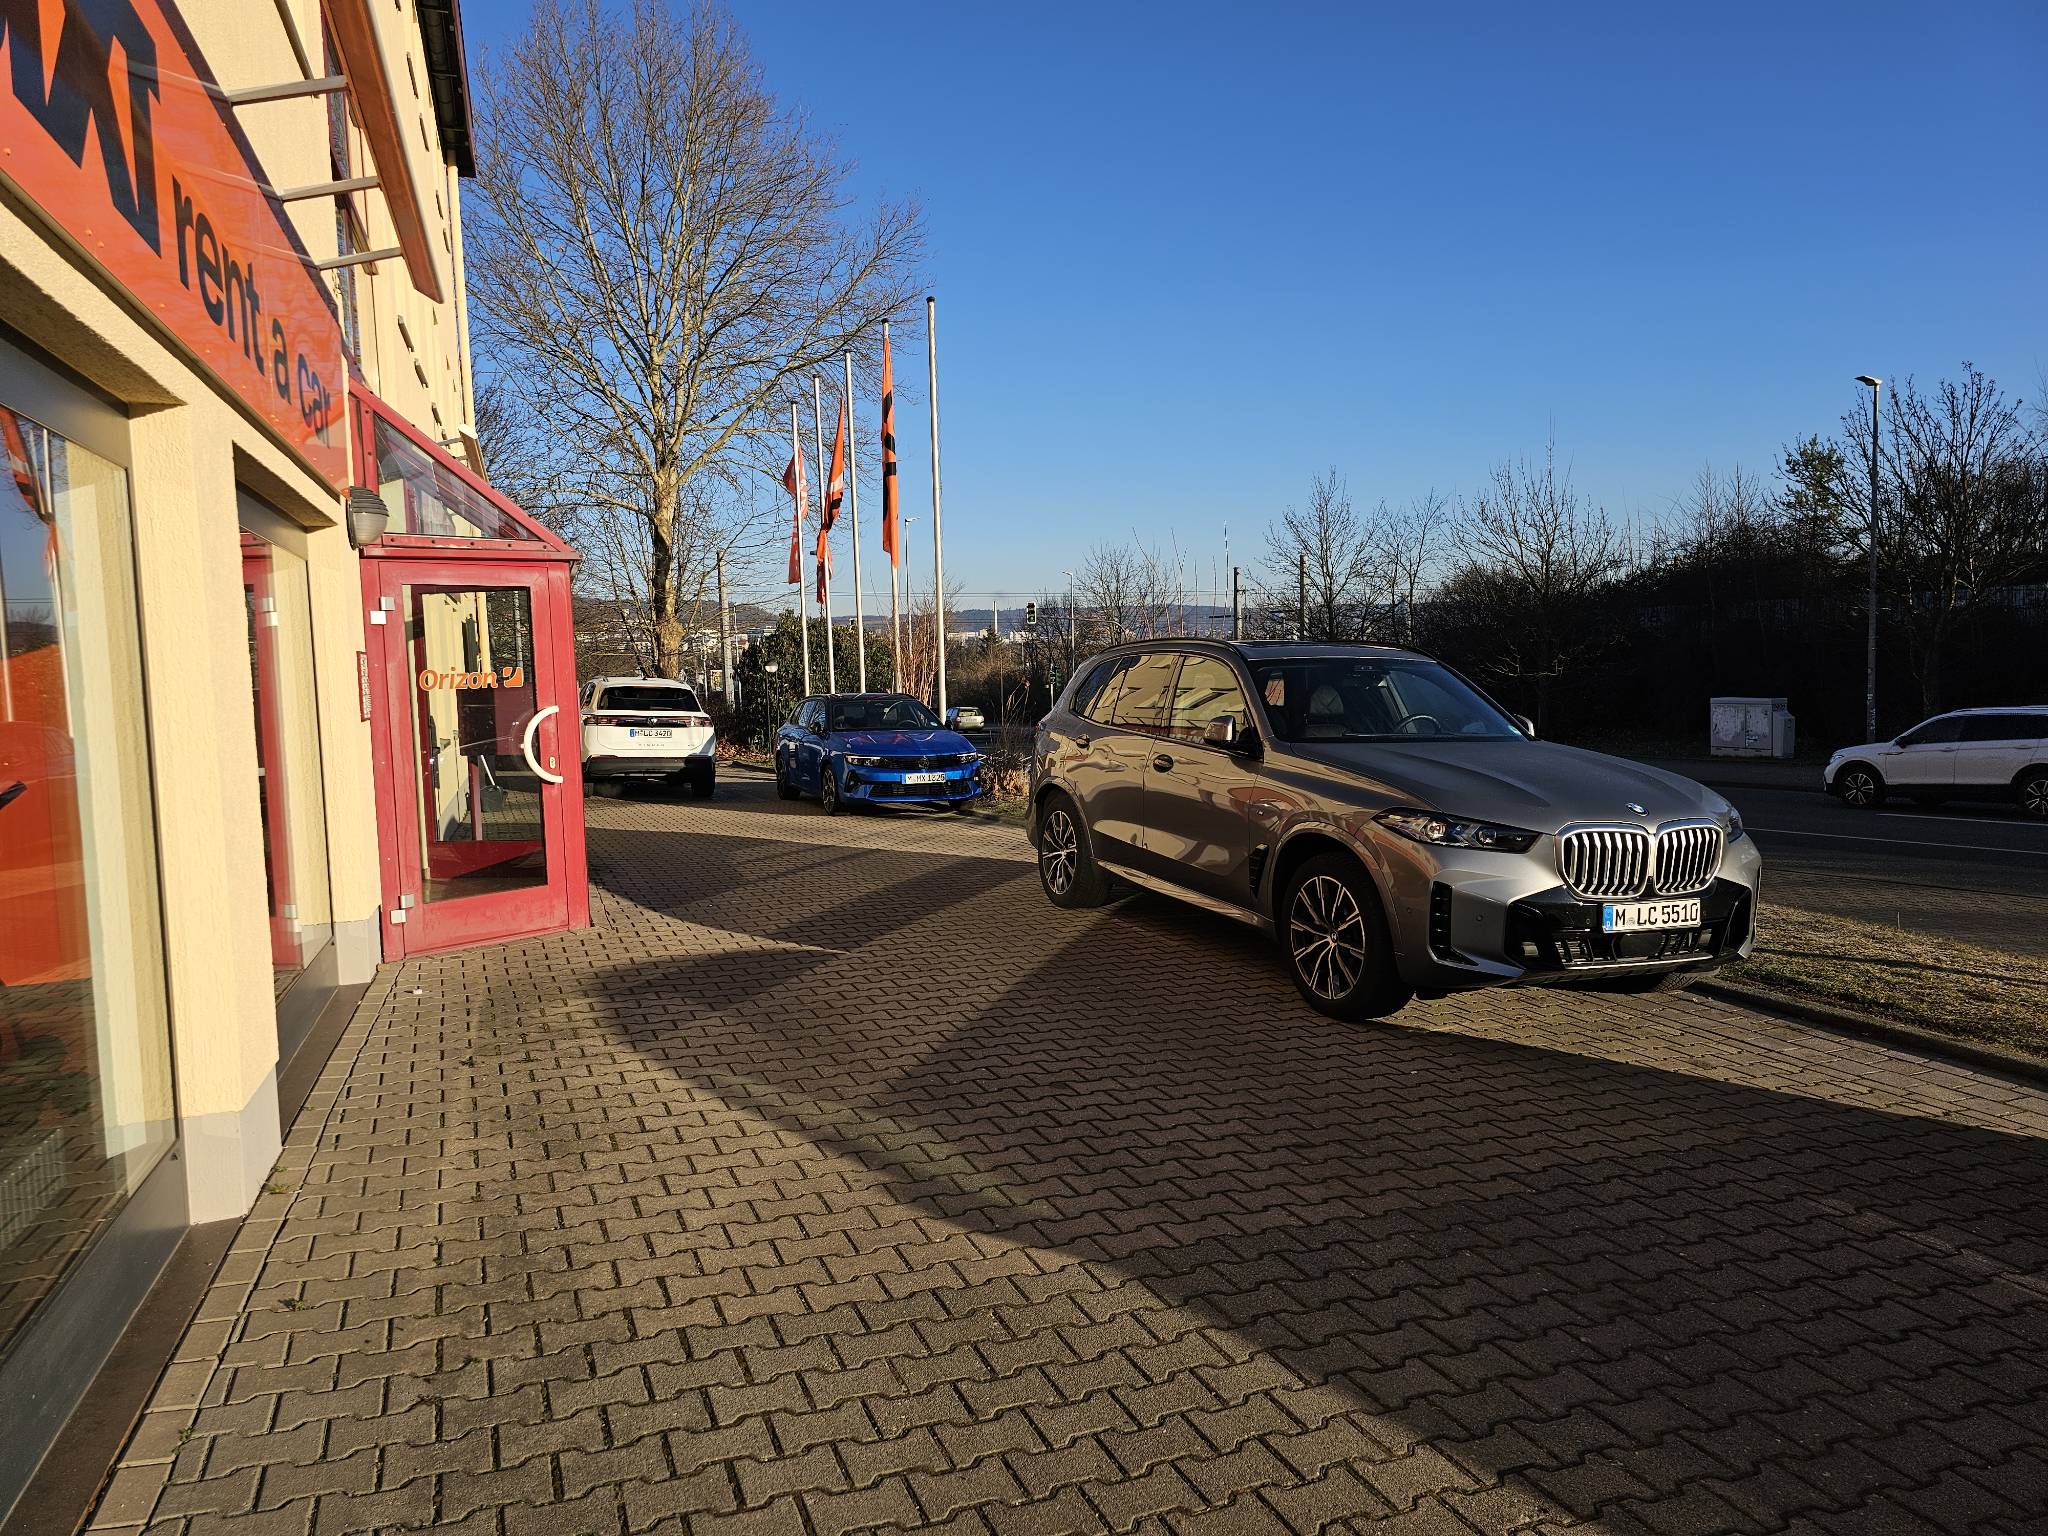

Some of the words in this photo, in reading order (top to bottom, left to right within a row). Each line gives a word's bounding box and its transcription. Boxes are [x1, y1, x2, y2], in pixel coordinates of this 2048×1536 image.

[172, 174, 265, 376] rent
[272, 318, 292, 405] a
[297, 353, 331, 448] car
[419, 667, 498, 691] Orizon
[1615, 908, 1626, 927] M
[1637, 906, 1658, 926] LC
[1661, 903, 1699, 924] 5510
